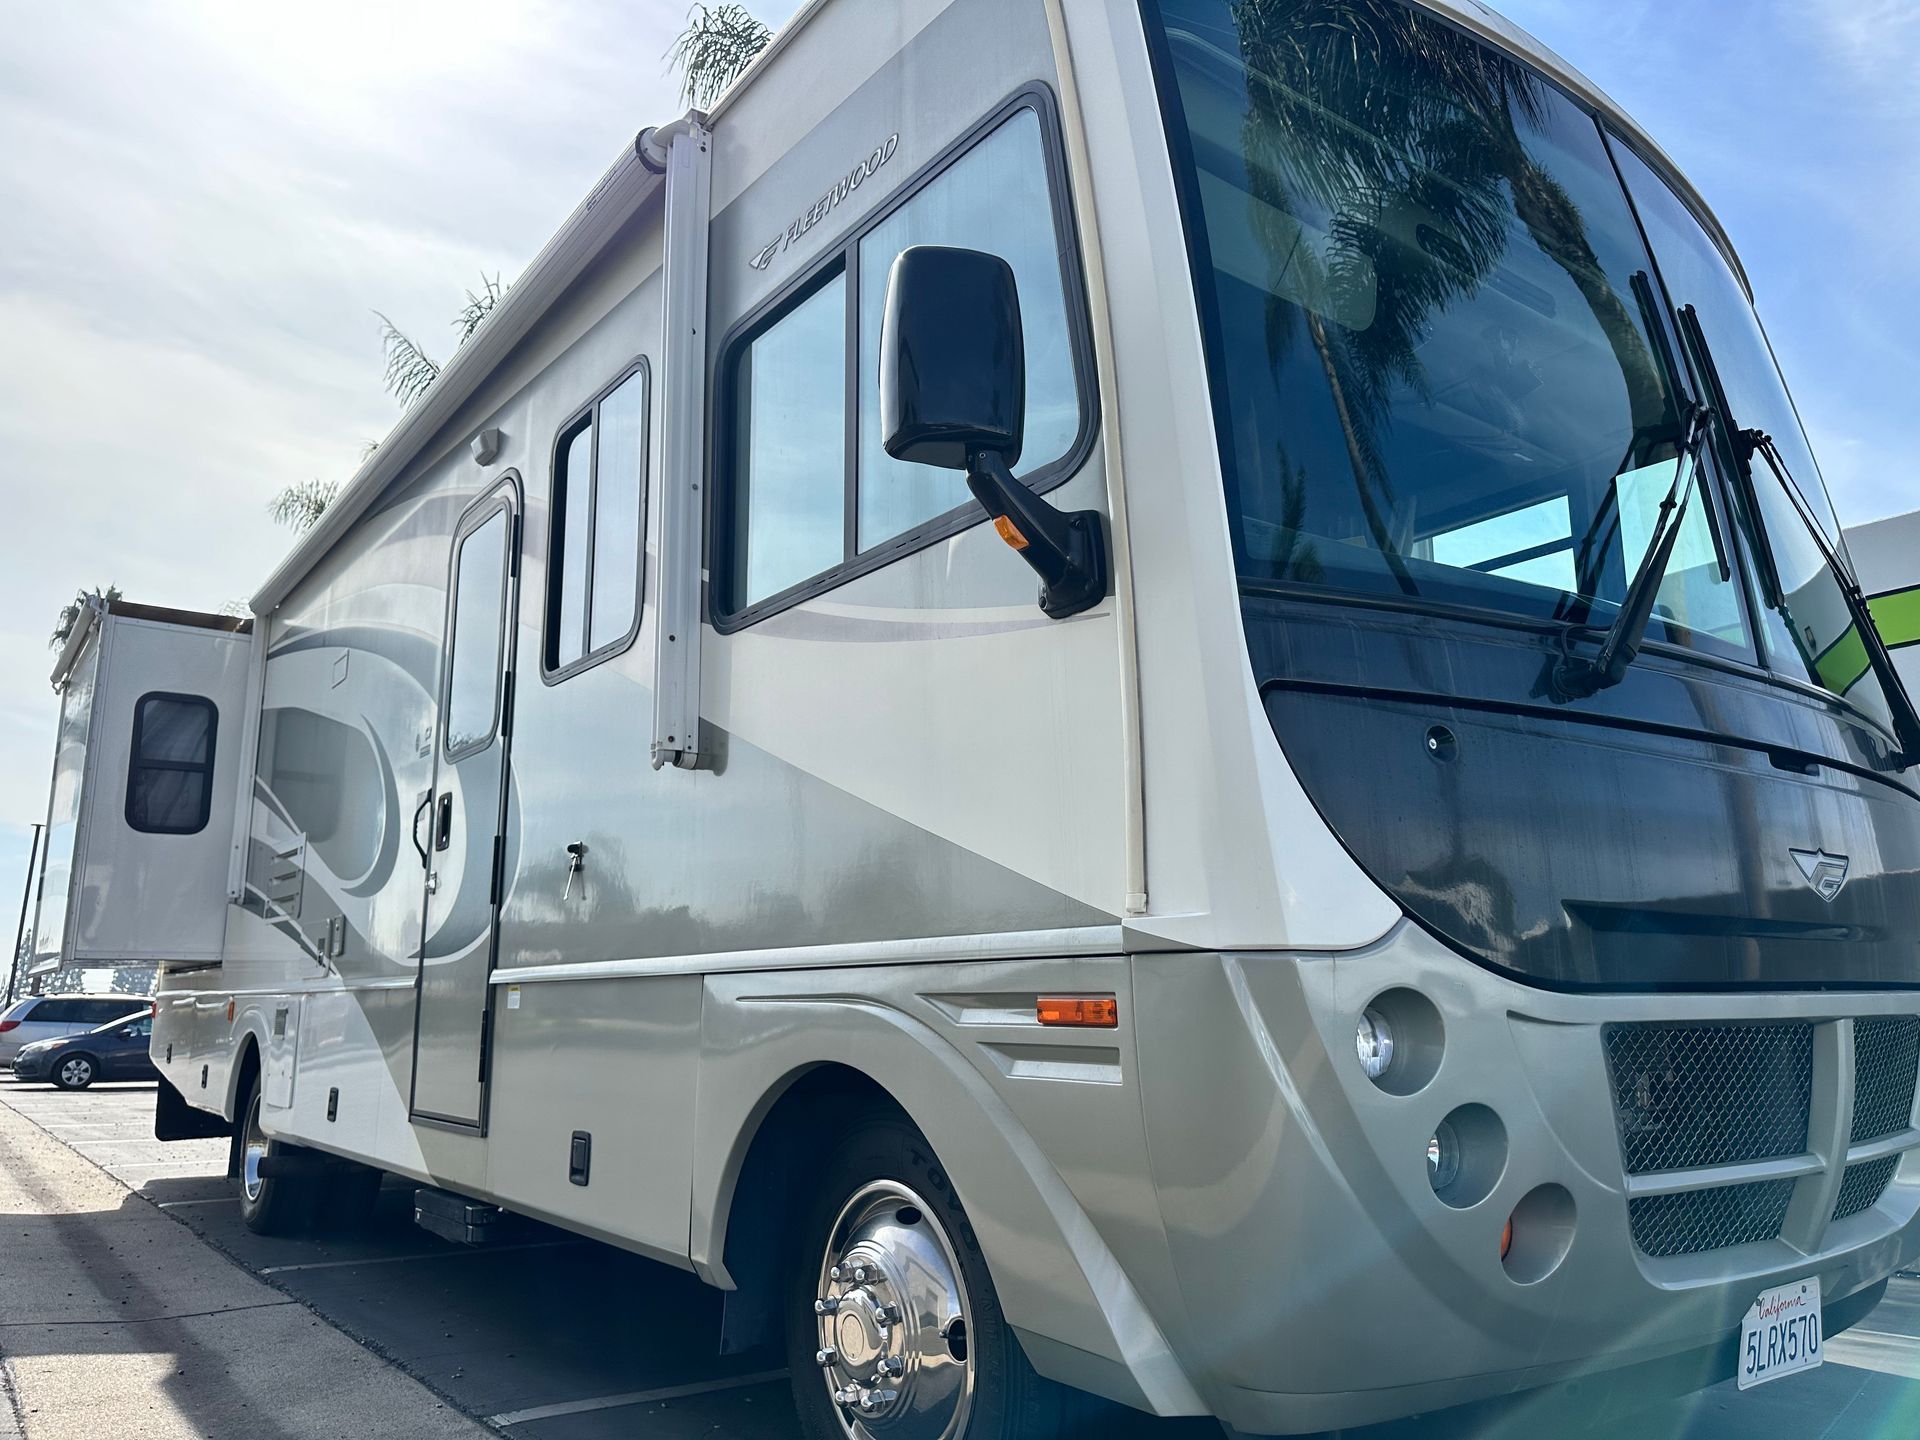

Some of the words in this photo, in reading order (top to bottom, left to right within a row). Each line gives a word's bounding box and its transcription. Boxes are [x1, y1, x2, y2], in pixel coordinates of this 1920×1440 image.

[782, 133, 899, 252] FLEETWOOD
[1758, 1294, 1806, 1321] California
[1746, 1313, 1818, 1374] 5LRX570
